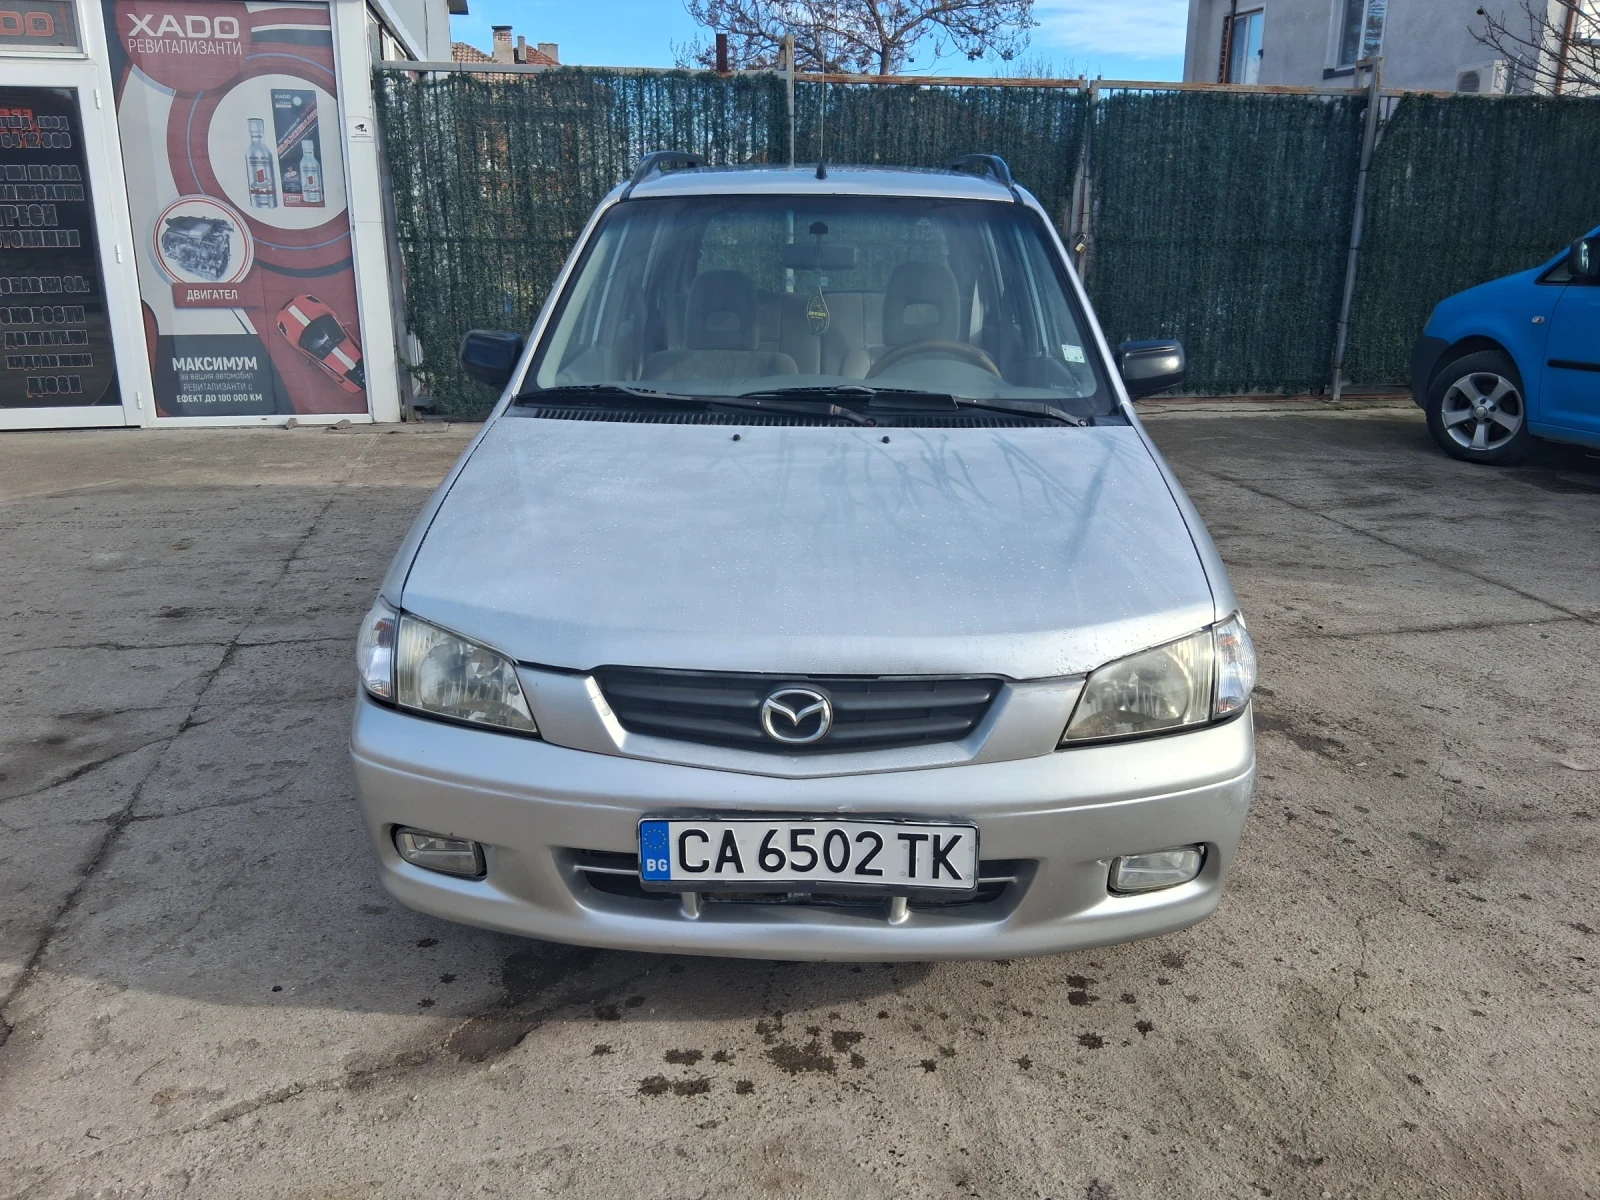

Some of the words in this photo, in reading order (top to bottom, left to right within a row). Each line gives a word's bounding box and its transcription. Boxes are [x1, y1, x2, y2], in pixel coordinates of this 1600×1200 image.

[126, 13, 240, 39] XADO
[128, 38, 243, 55] РЕВИТАЛИЗАНТИ
[186, 289, 239, 302] ДВИГАТЕЛ
[172, 356, 258, 371] МАКСИМУМ
[215, 371, 254, 380] автомобил
[183, 382, 246, 392] РЕВИТАЛИЗАНТИ
[176, 394, 202, 403] ЕФЕКТ
[205, 394, 217, 403] ДО
[218, 394, 232, 402] 100
[233, 393, 248, 402] 000
[249, 393, 263, 401] КМ
[678, 828, 745, 874] CA
[757, 828, 885, 877] 6502
[897, 833, 972, 881] TK
[646, 858, 668, 872] BG
